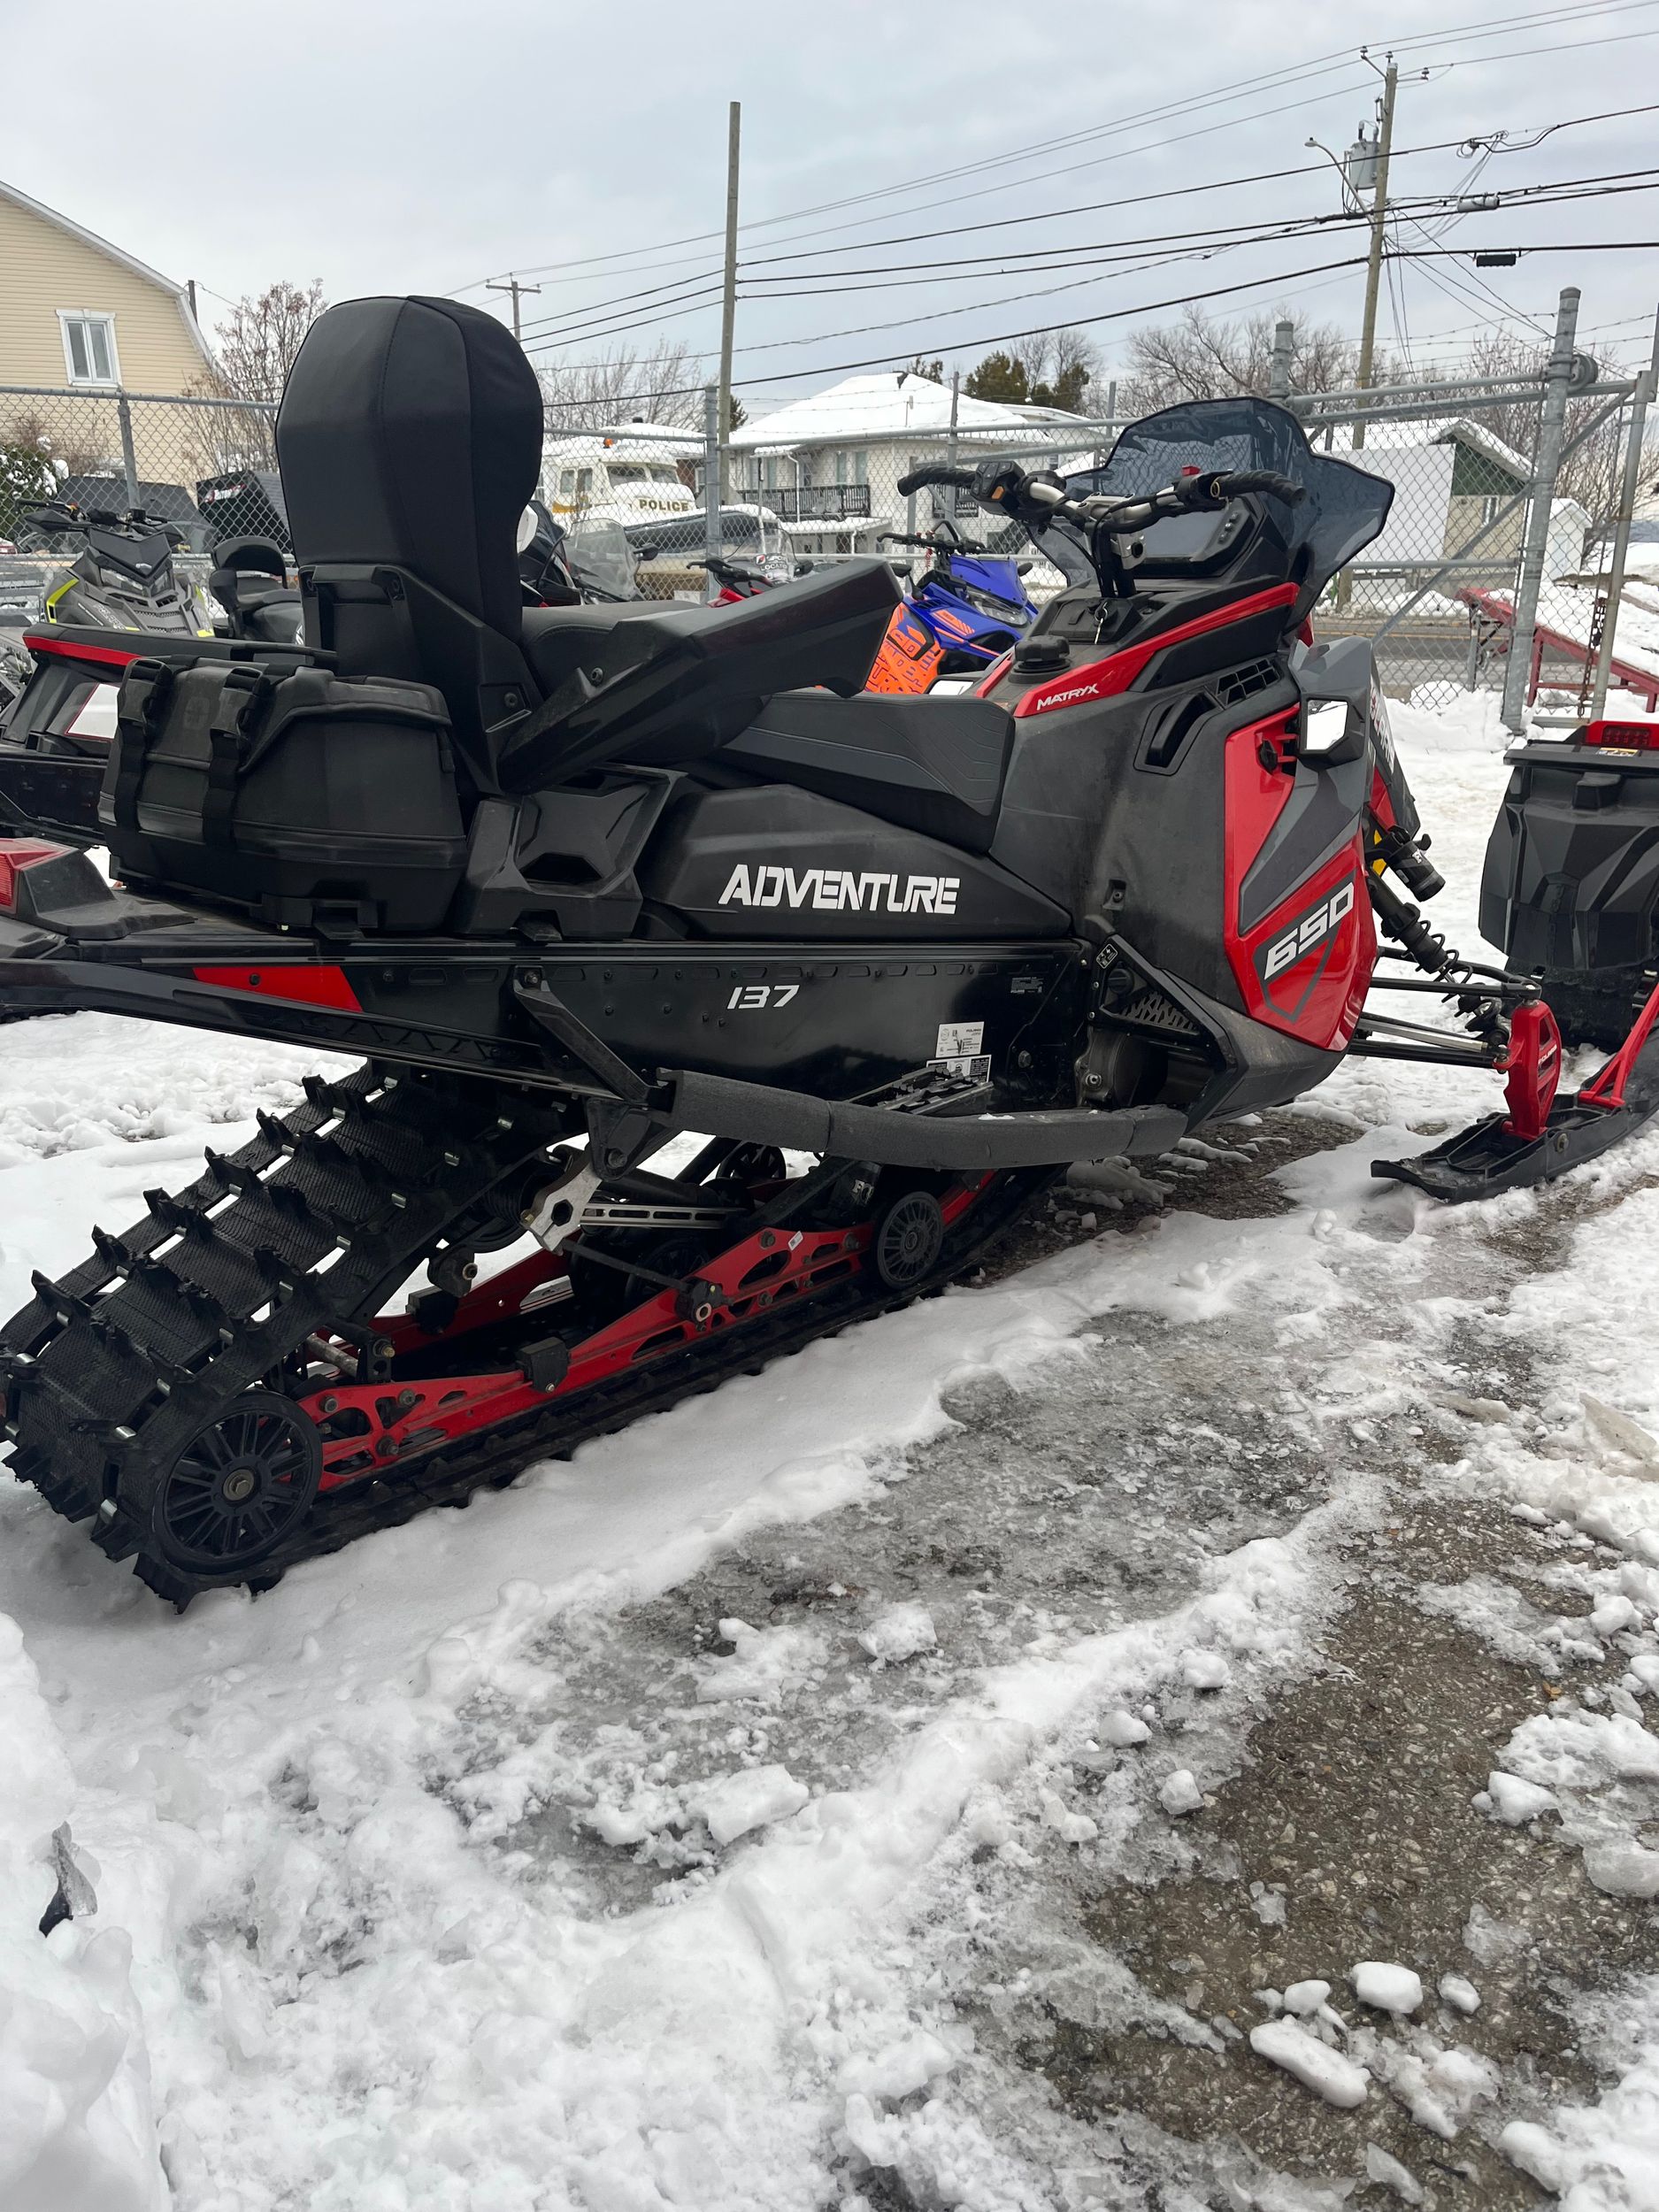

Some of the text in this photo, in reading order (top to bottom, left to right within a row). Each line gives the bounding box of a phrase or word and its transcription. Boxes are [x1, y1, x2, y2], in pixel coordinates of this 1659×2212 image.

[639, 499, 689, 511] POLICE
[1036, 682, 1100, 711] MATRYX
[718, 864, 961, 915] ADVENTURE
[1263, 881, 1355, 980] 650
[726, 984, 800, 1010] 137
